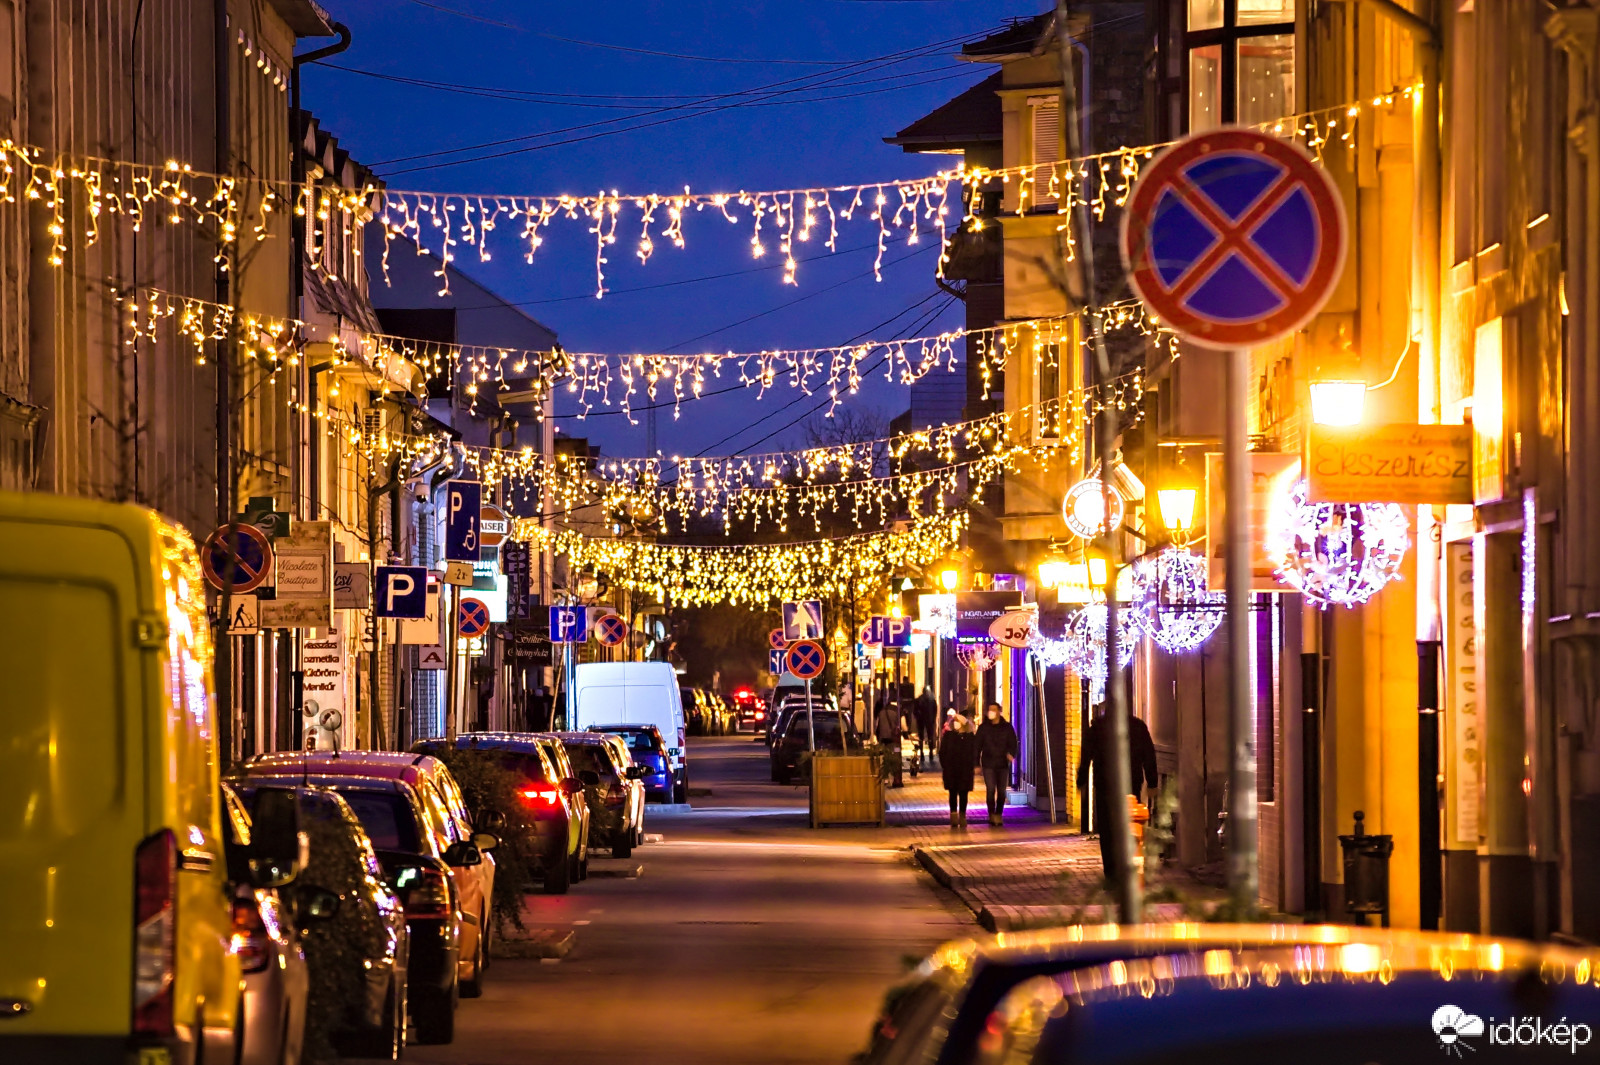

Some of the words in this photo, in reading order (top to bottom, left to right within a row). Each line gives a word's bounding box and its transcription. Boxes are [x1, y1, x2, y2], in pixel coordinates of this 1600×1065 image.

[450, 491, 463, 526] P
[480, 522, 504, 532] AISER
[277, 559, 318, 571] Nicolette
[277, 571, 318, 589] Boutique
[386, 573, 415, 612] P
[558, 610, 576, 638] P
[889, 620, 905, 644] P
[304, 654, 340, 664] ozmetika
[861, 659, 869, 670] P
